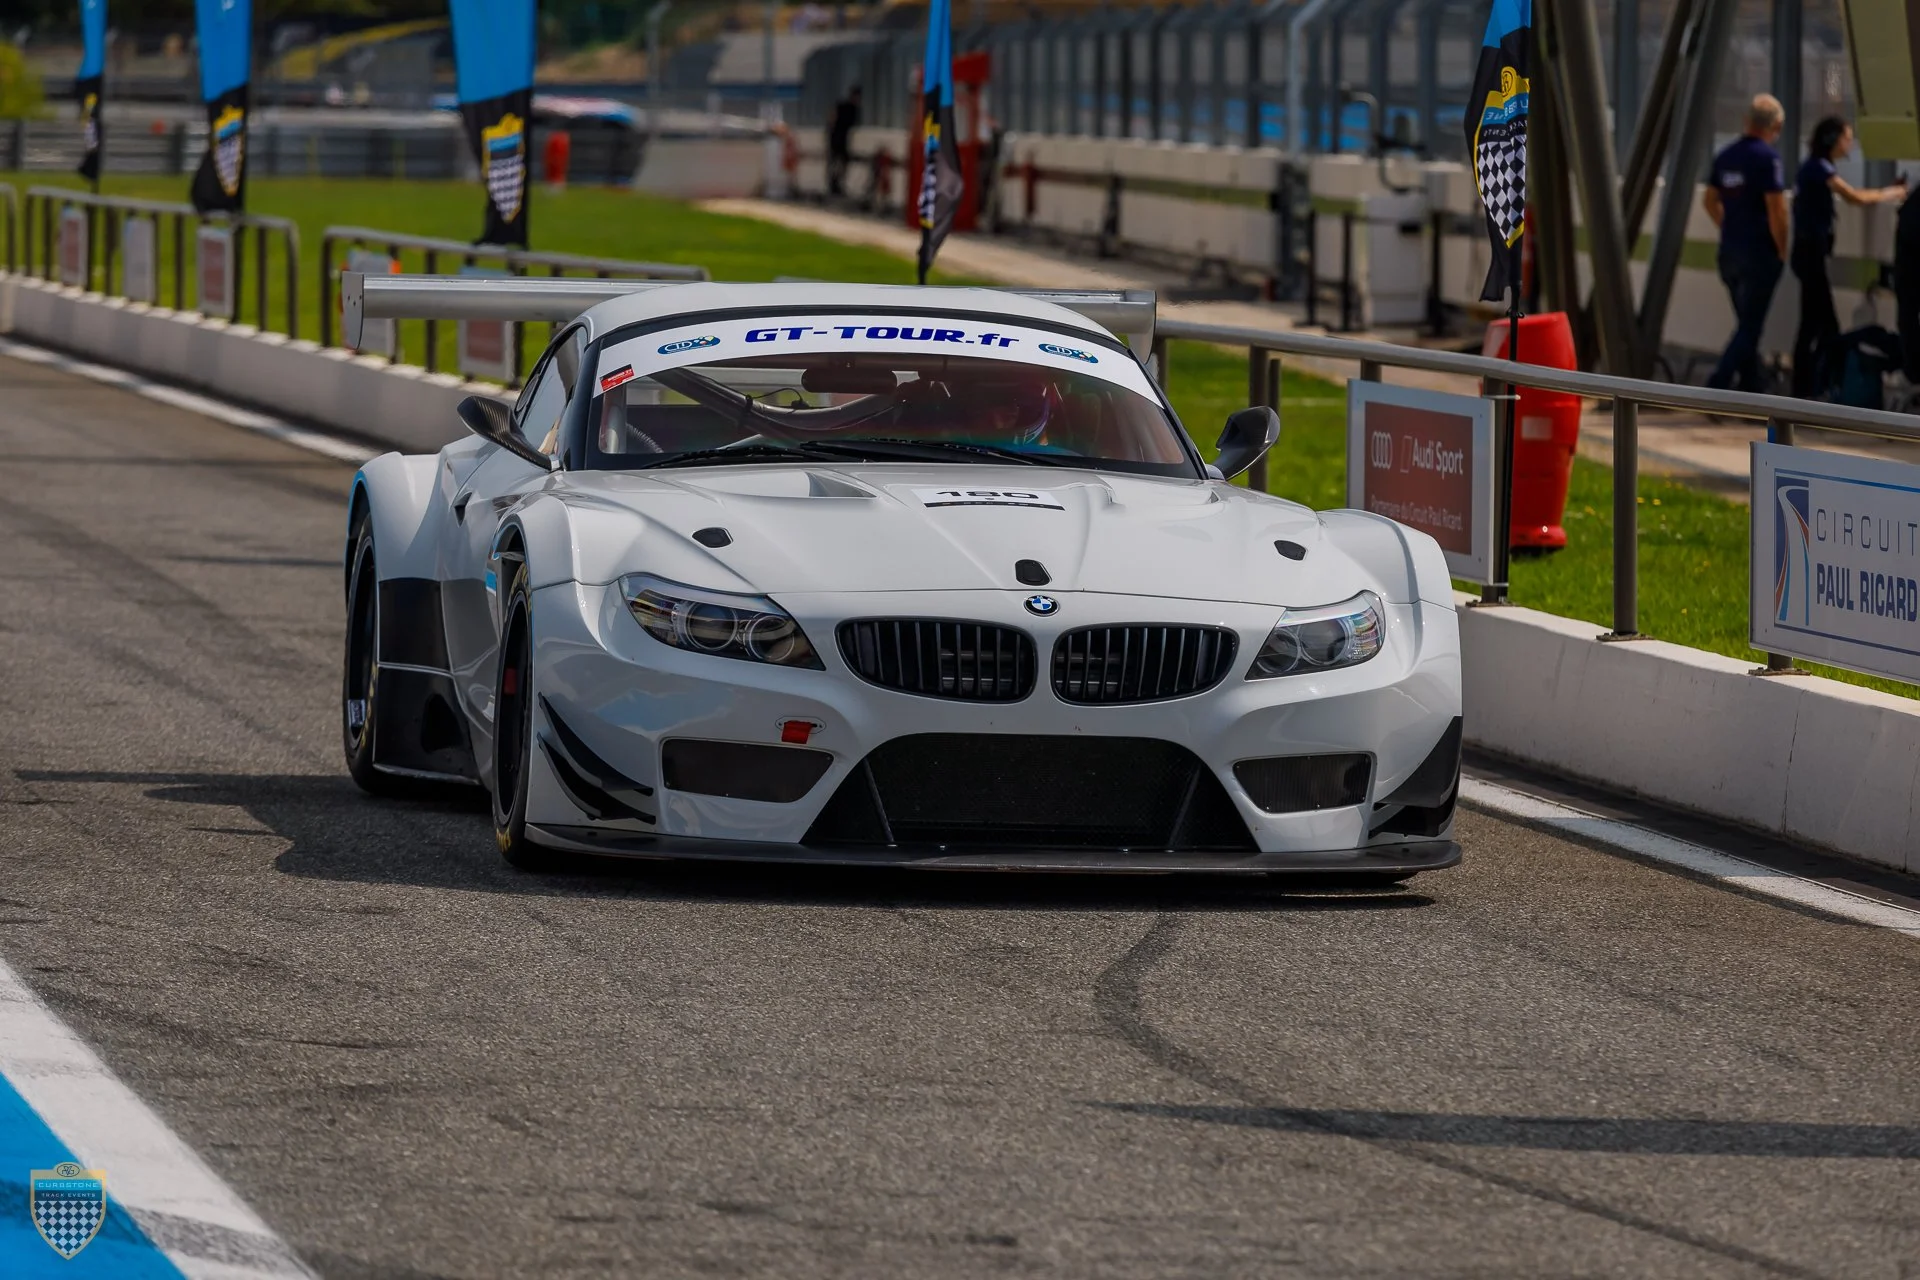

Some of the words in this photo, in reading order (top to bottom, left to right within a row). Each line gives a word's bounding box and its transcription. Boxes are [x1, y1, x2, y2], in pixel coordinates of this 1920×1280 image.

[745, 326, 1020, 348] GT-TOUR.fr
[1413, 438, 1434, 469] Audi
[1436, 441, 1464, 480] Sport
[936, 491, 1040, 499] 180
[1816, 508, 1918, 557] CIRCUIT
[1816, 563, 1854, 610] PAUL
[1860, 570, 1918, 622] RICARD
